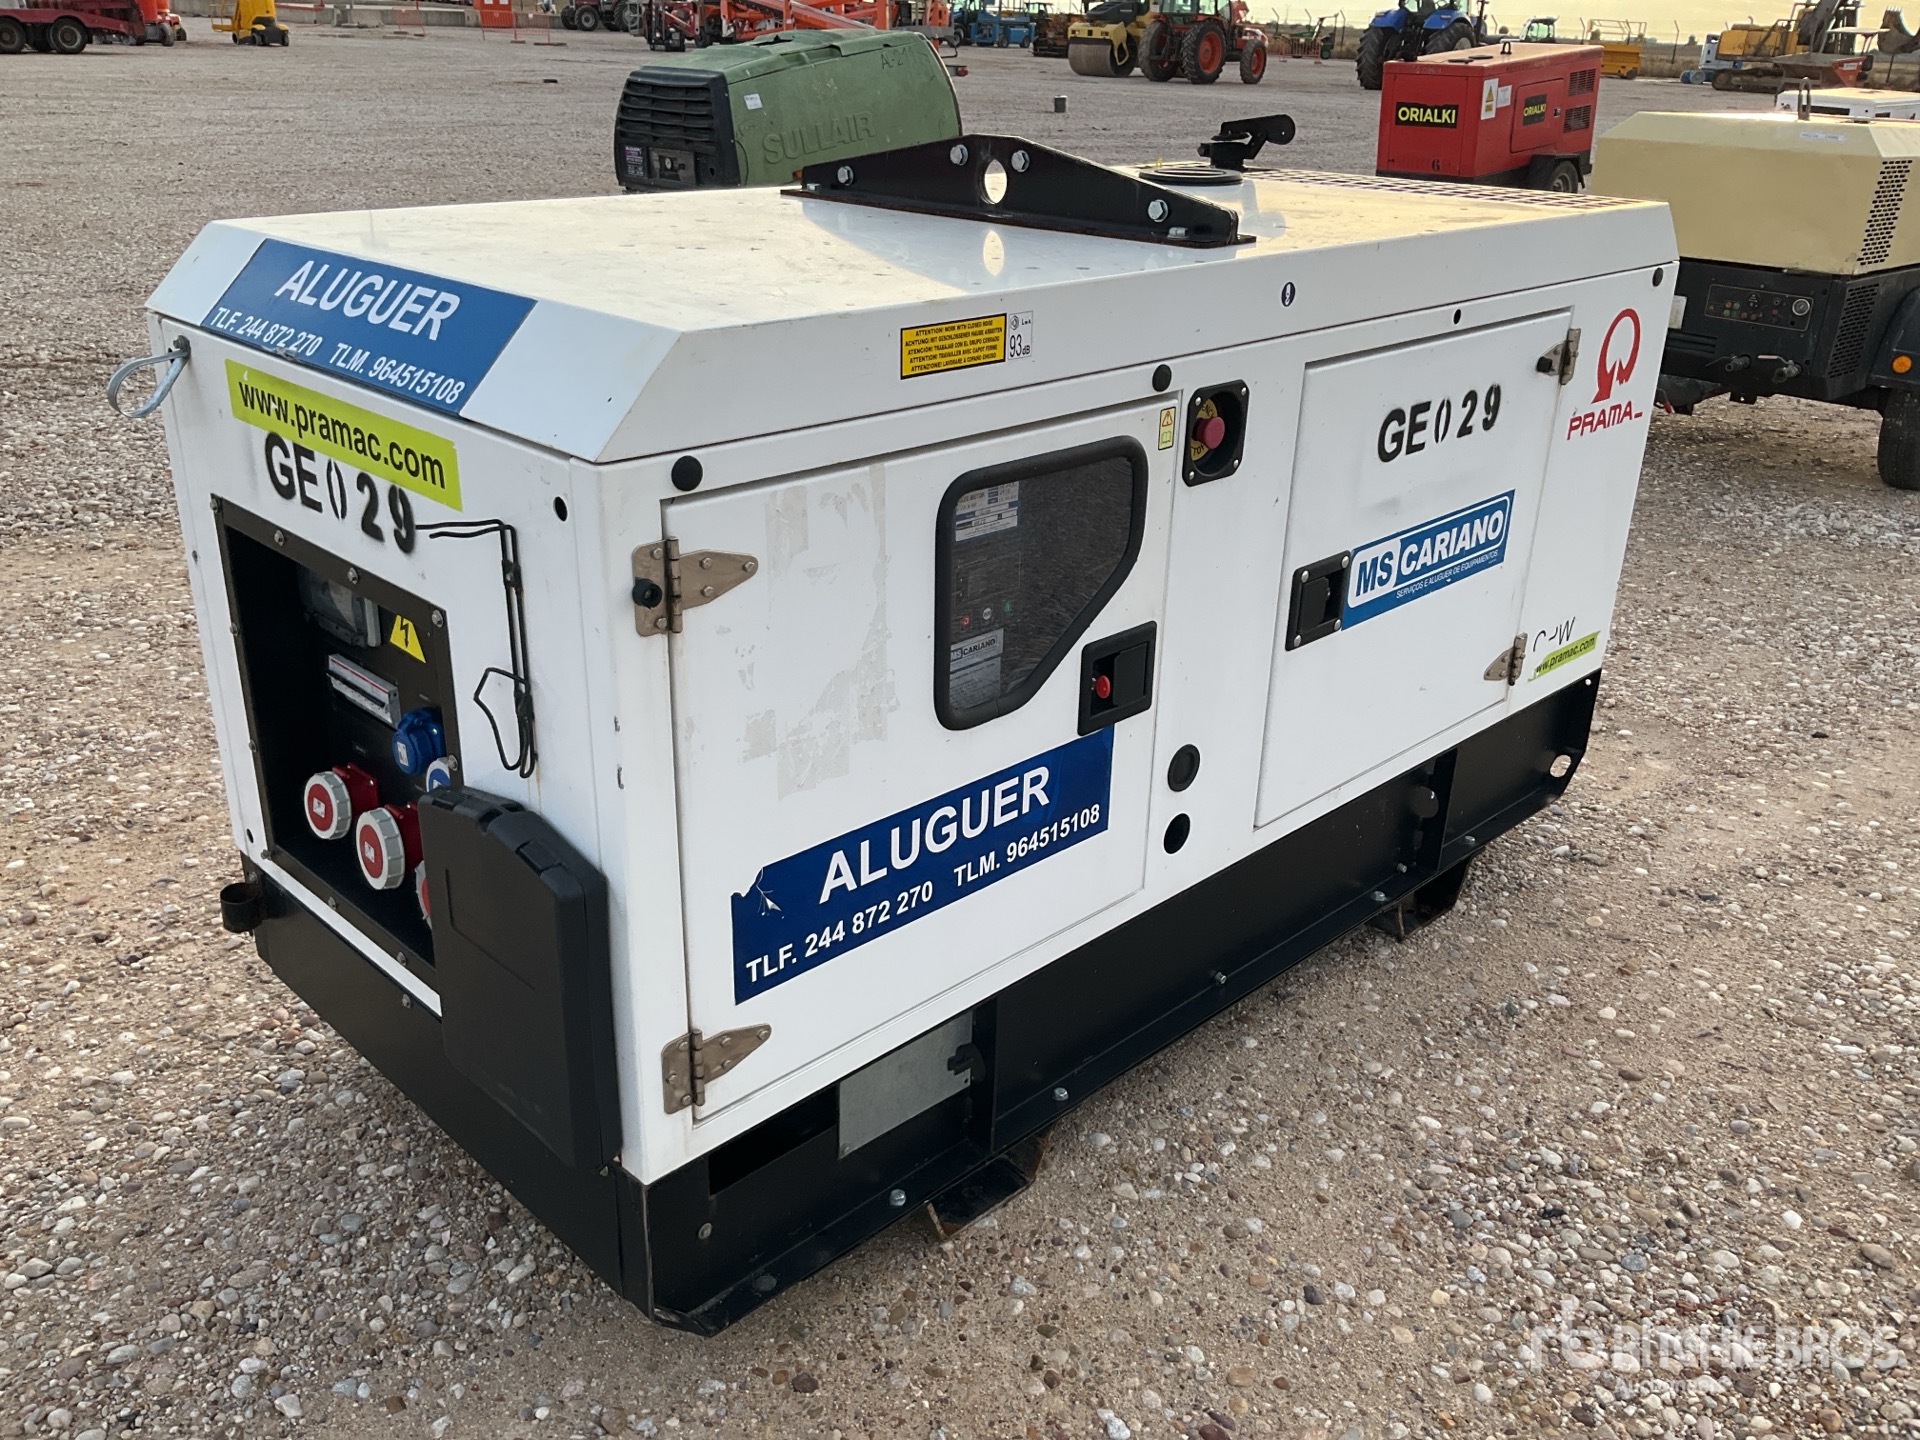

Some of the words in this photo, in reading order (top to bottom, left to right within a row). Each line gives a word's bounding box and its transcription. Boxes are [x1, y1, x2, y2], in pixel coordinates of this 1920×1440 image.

[762, 111, 876, 164] SULLAIR
[1398, 106, 1456, 124] ORIALKI
[1523, 103, 1547, 117] ORIALKI
[274, 260, 460, 340] ALUGUER
[211, 308, 235, 332] TLF.
[237, 316, 263, 340] 244
[263, 323, 291, 348] 872
[290, 332, 323, 356] 270
[330, 342, 370, 373] TLM.
[369, 356, 465, 404] 964515108
[239, 381, 446, 489] www.pramac.com
[1356, 550, 1394, 598] MS
[1401, 510, 1504, 576] CARIANO
[1396, 581, 1424, 599] SERVIÇOS
[1428, 568, 1453, 585] ALUGUER
[1452, 565, 1461, 576] DE
[1460, 550, 1499, 573] EQUIPAMENTOS
[963, 638, 996, 656] CARIANO
[819, 766, 1050, 904] ALUGUER
[746, 943, 796, 983] TLF.
[805, 920, 845, 958] 244
[852, 900, 891, 934] 872
[896, 880, 933, 914] 270
[954, 851, 999, 887] TLM.
[1006, 804, 1100, 863] 964515108
